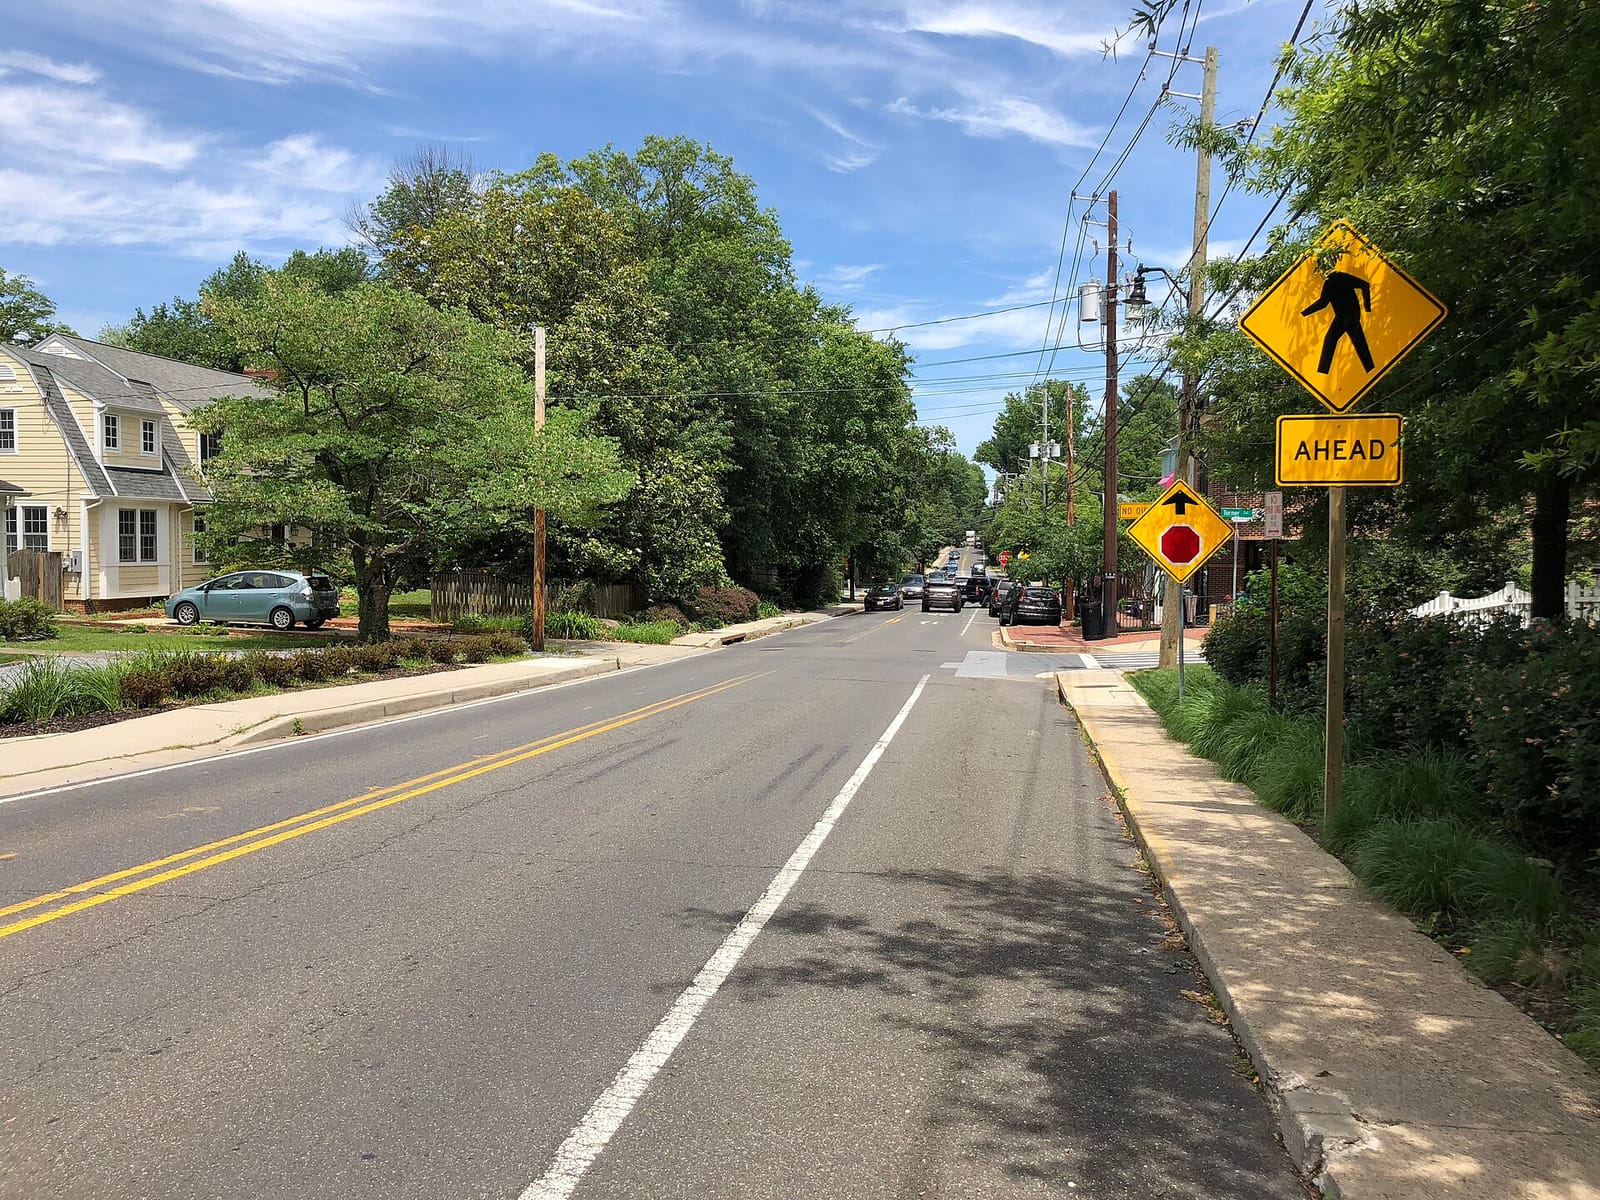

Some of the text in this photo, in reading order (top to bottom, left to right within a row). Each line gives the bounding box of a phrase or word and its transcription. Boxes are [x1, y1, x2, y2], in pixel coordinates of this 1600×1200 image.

[1294, 439, 1385, 461] AHEAD
[1122, 506, 1146, 515] NO OU
